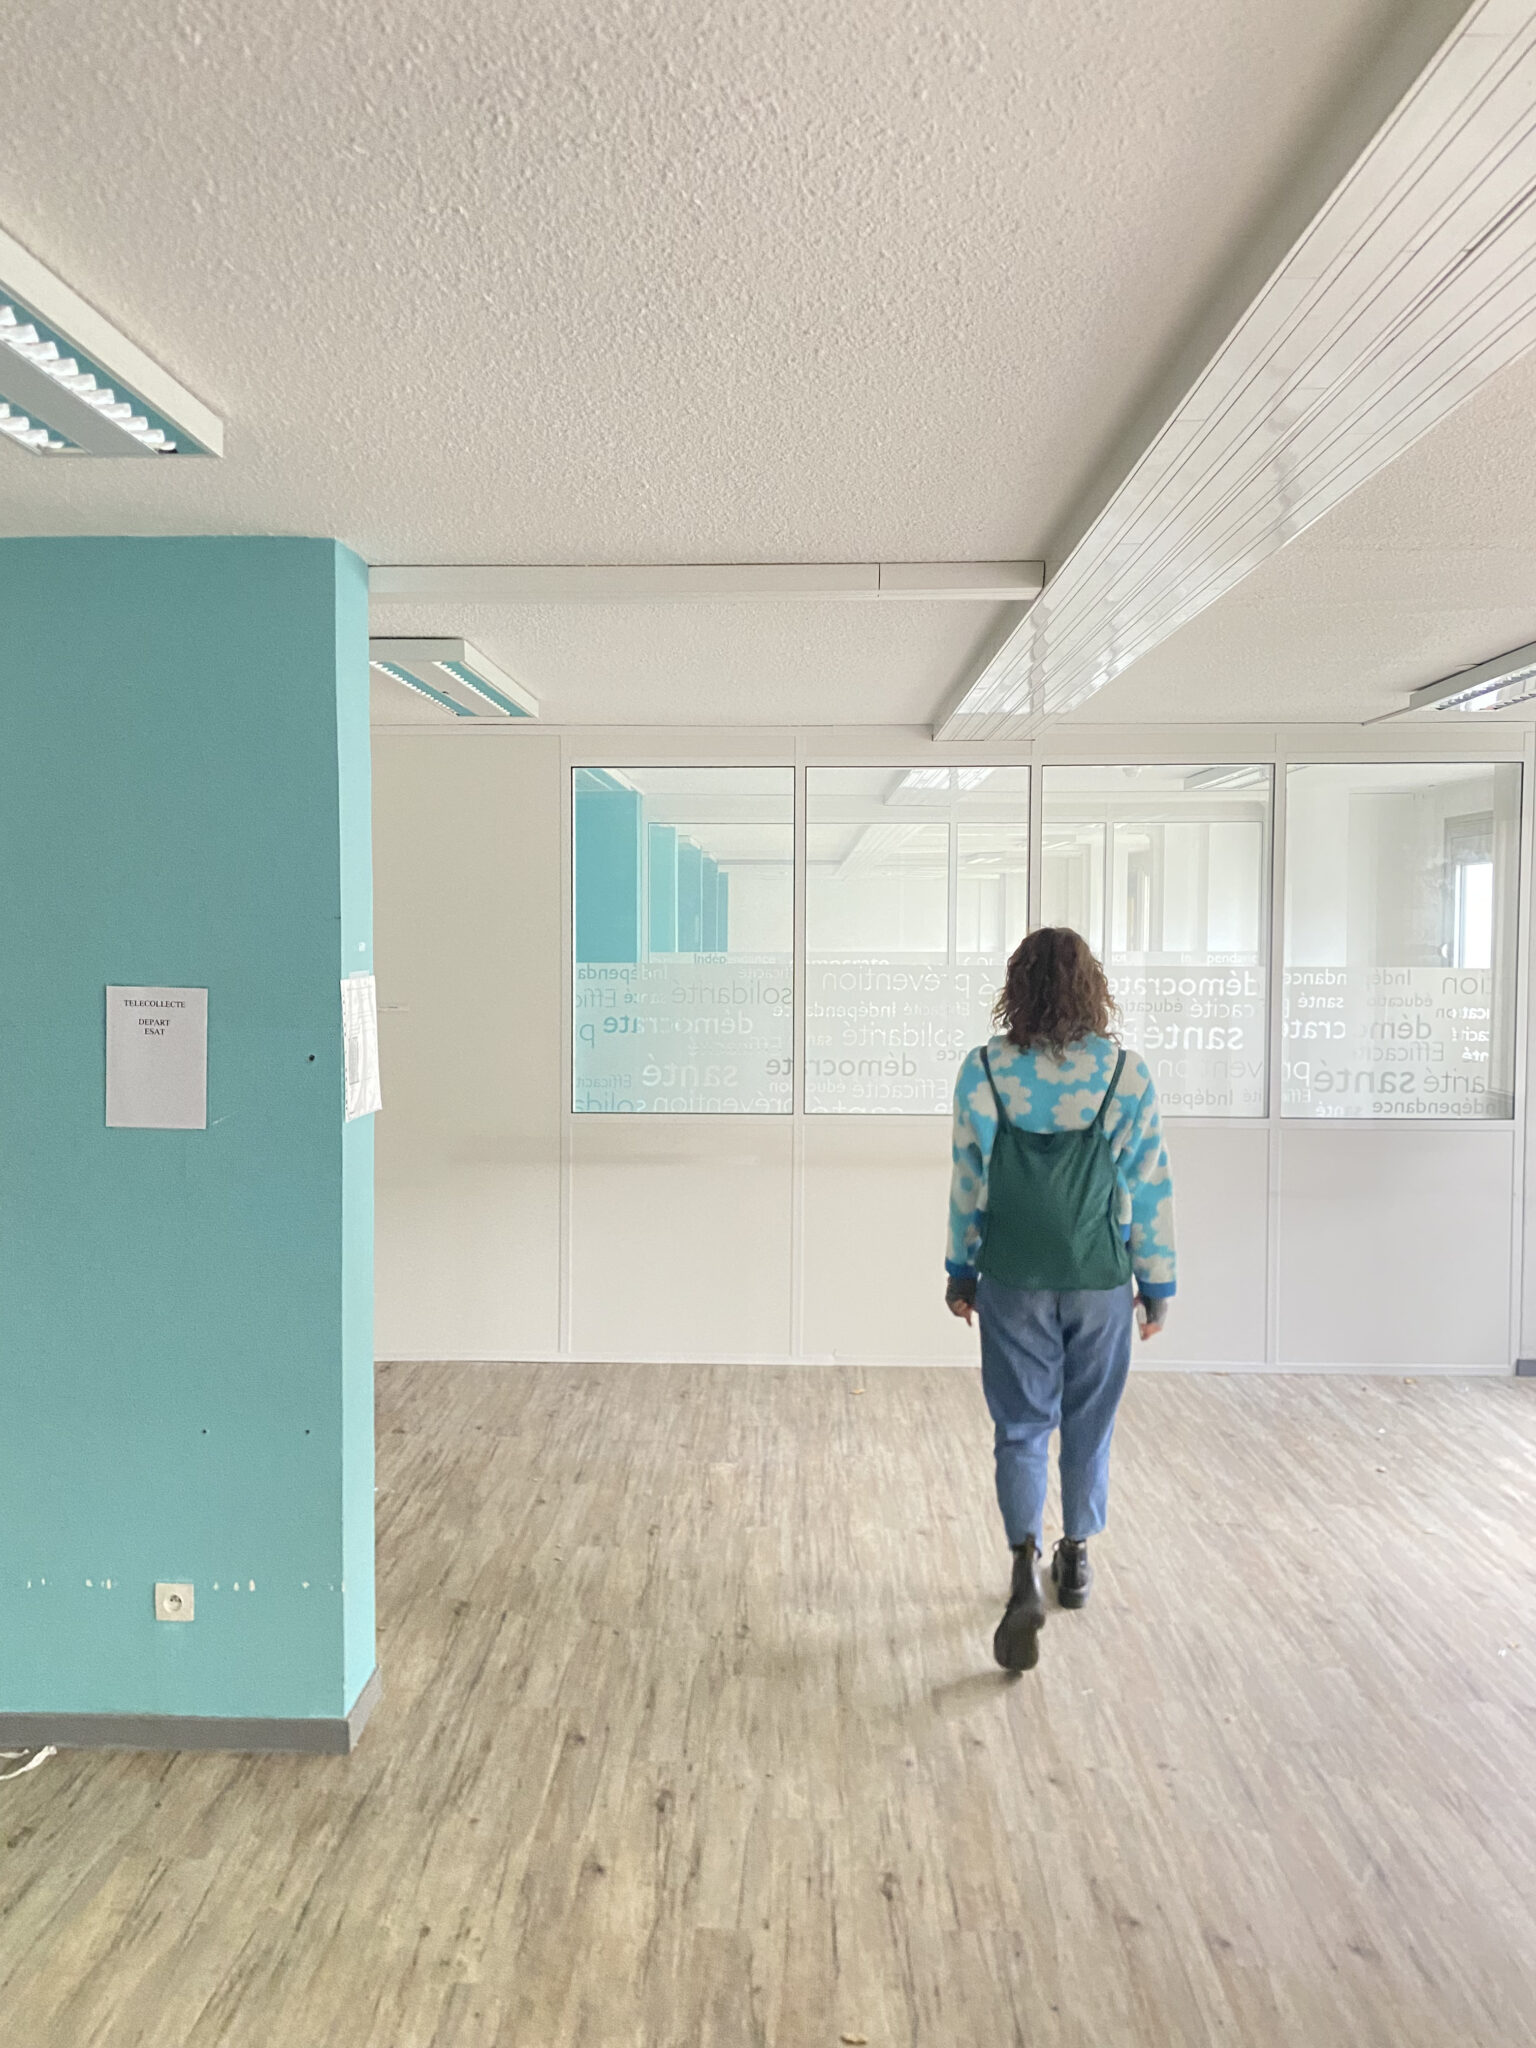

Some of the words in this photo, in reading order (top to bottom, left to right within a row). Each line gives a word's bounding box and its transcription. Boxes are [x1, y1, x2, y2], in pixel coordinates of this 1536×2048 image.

[124, 999, 186, 1008] TELECOLLECTE
[138, 1018, 170, 1027] DEPART
[144, 1028, 165, 1036] ESAT
